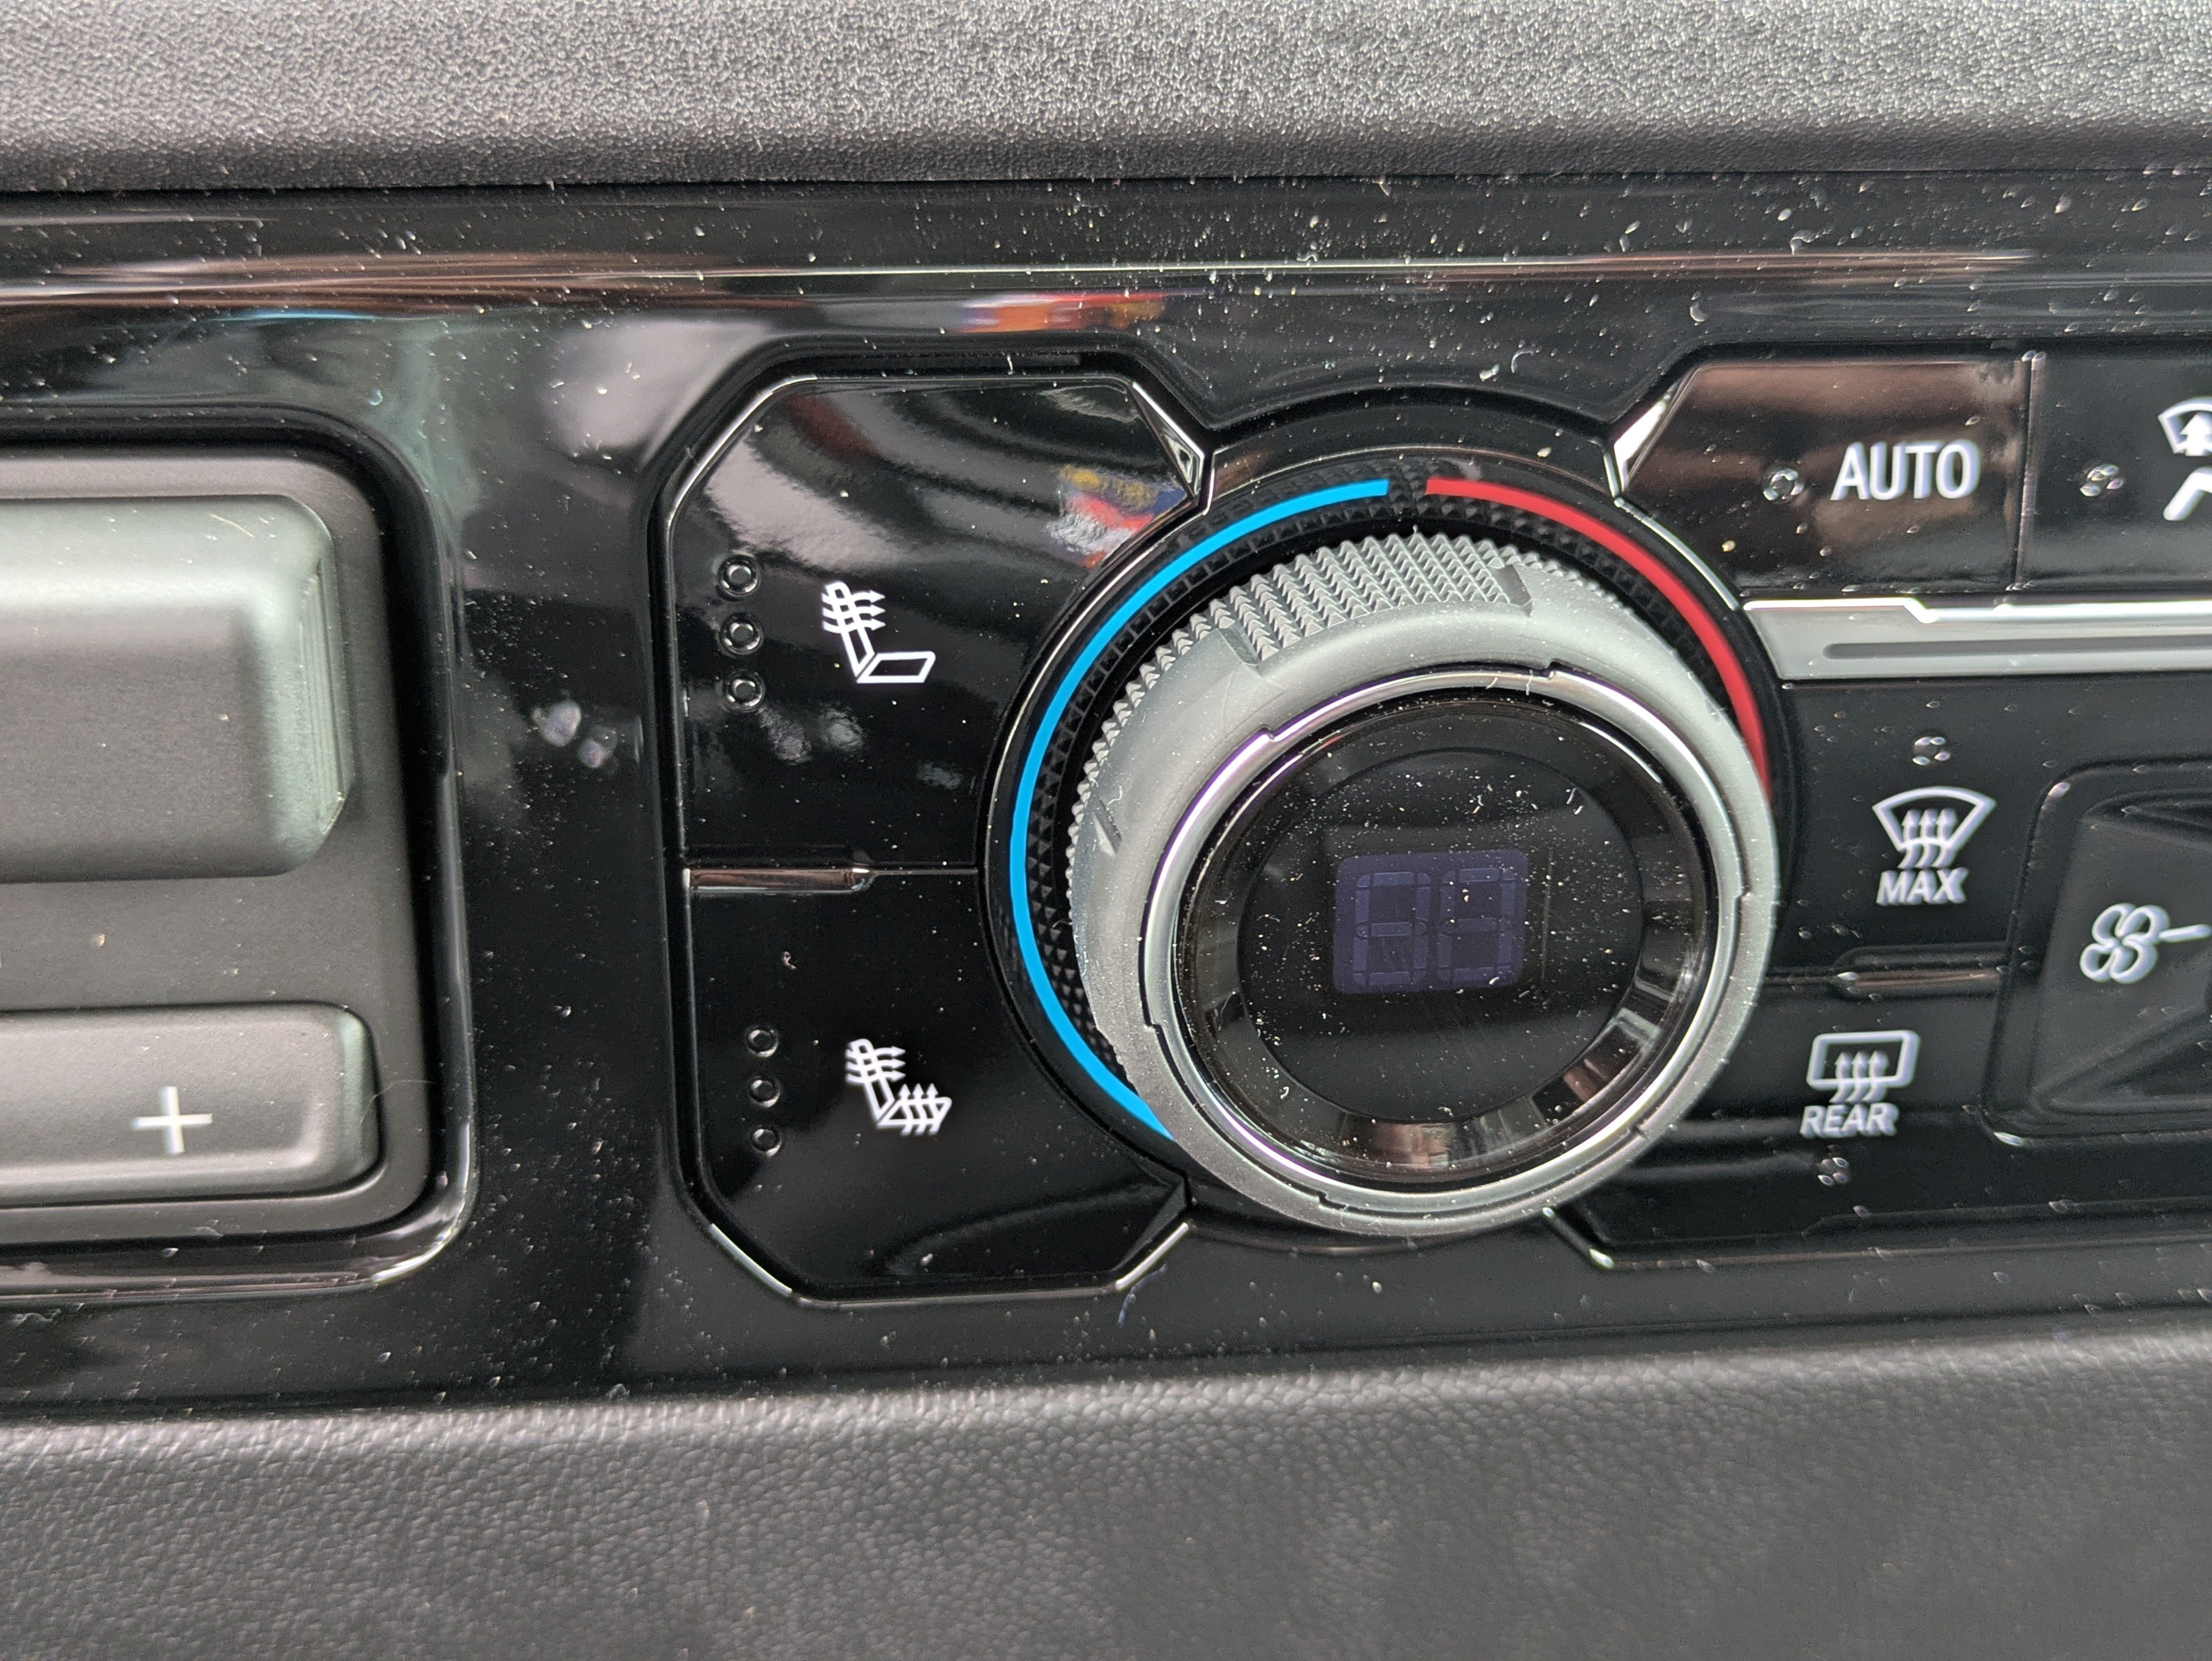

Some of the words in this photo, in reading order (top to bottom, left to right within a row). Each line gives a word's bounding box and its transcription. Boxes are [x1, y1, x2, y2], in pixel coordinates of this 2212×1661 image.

[1831, 439, 1981, 501] AUTO
[1876, 867, 1970, 906] MAX
[1799, 1103, 1900, 1138] REAR
